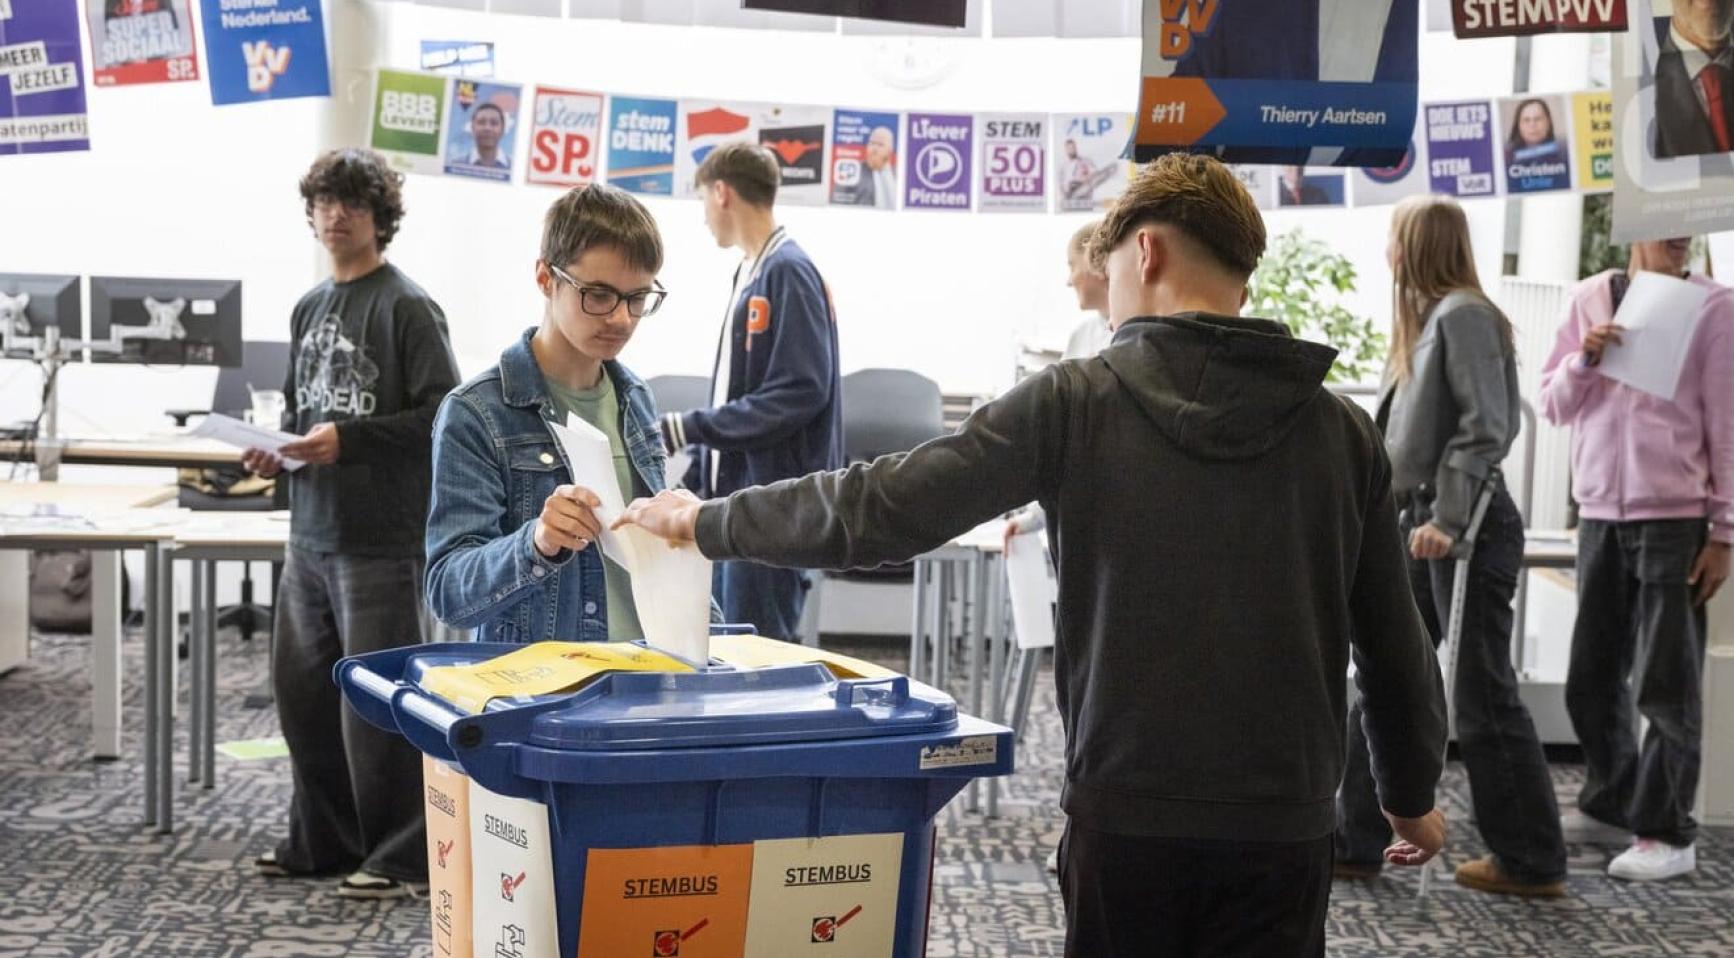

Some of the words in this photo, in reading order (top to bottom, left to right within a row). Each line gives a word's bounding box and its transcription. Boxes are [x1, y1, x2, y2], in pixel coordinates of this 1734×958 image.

[107, 9, 174, 41] SUPER
[222, 6, 312, 28] Nederland.
[1463, 0, 1553, 29] STEM
[1556, 0, 1615, 23] PVV
[102, 30, 184, 65] SOCIAAL
[14, 67, 70, 90] JEZELF
[382, 90, 436, 114] BBB
[535, 98, 600, 129] Stem
[616, 109, 670, 132] stem
[1152, 102, 1185, 124] #11
[1261, 105, 1319, 128] Thierry
[1322, 107, 1386, 125] Aartsen
[911, 119, 969, 141] Liever
[986, 121, 1041, 138] STEM
[1082, 117, 1113, 137] LP
[532, 129, 592, 177] SP.
[611, 130, 673, 153] DENK
[1593, 138, 1613, 149] w
[991, 146, 1036, 174] 50
[1432, 158, 1471, 177] STEM
[1509, 162, 1566, 178] Christen
[909, 187, 968, 206] Piraten
[989, 178, 1035, 192] PLUS
[485, 813, 529, 846] STEMBUS
[785, 863, 872, 884] STEMBUS
[624, 875, 718, 896] STEMBUS
